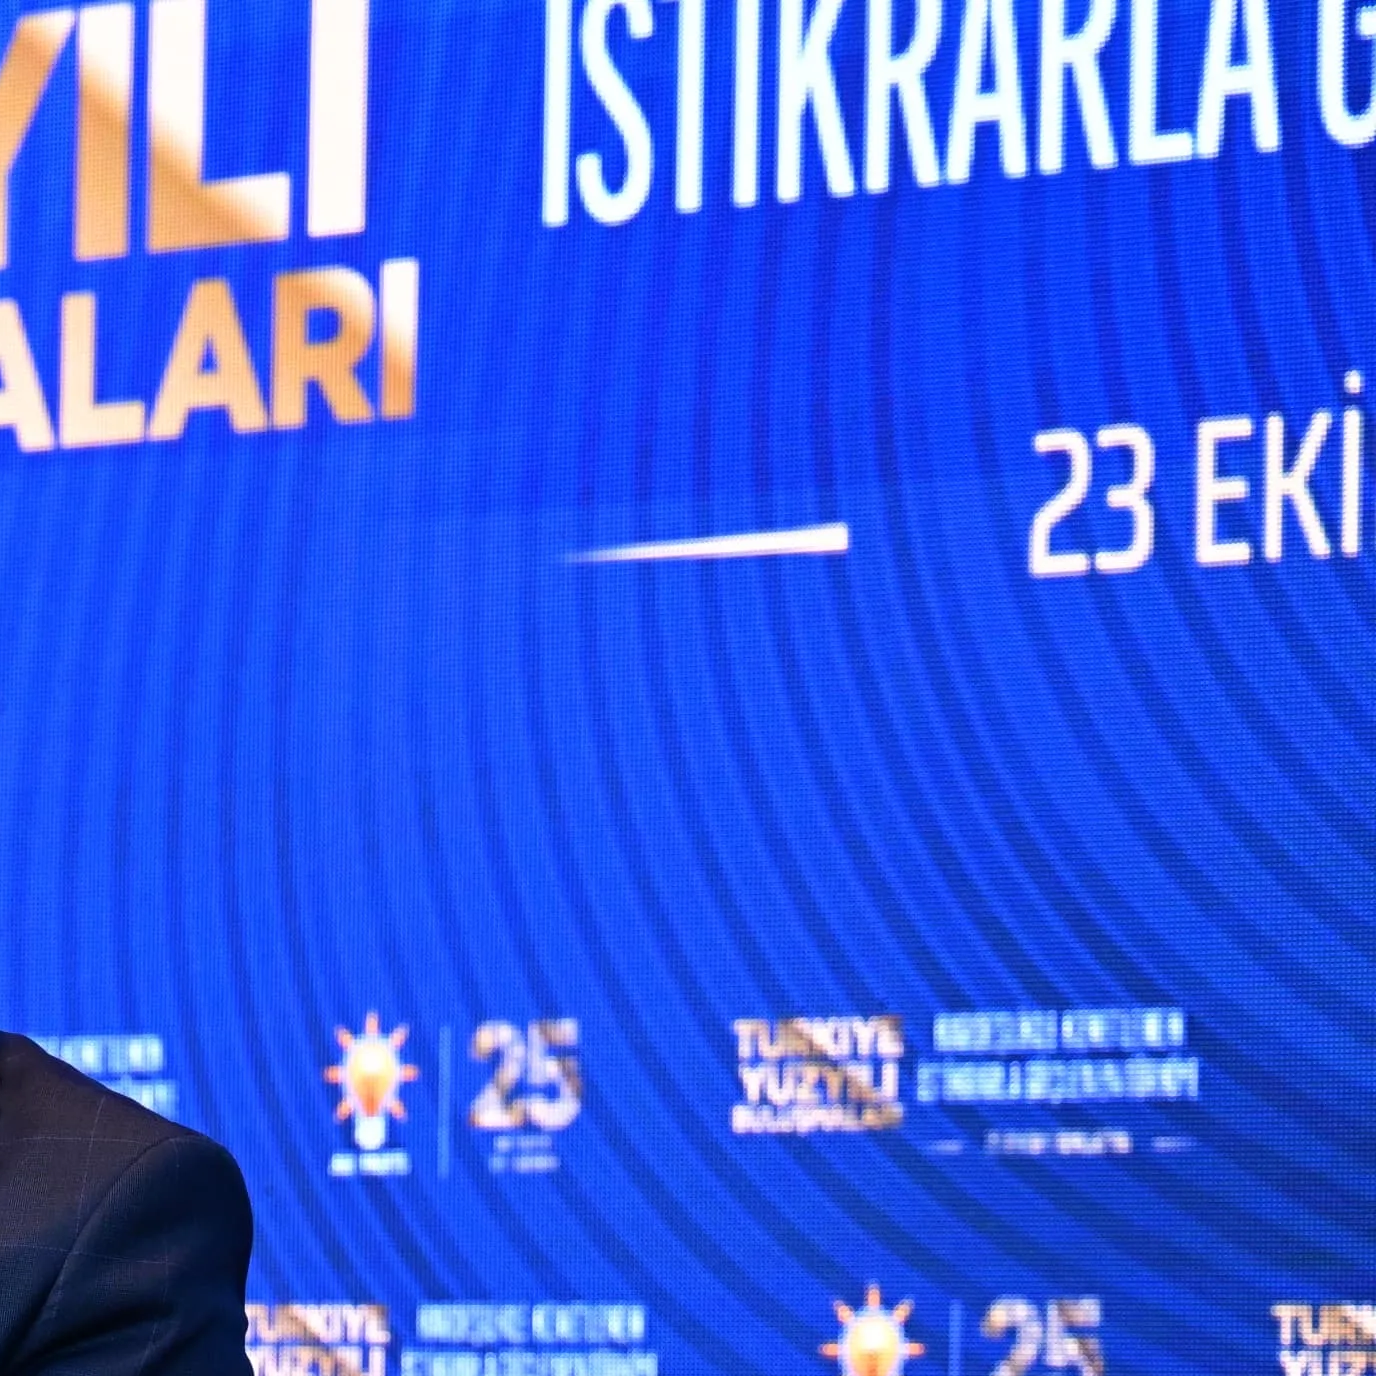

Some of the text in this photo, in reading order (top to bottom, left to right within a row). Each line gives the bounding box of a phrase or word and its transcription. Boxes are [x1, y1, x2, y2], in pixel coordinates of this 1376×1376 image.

[1028, 369, 1363, 579] 23 EKİ
[469, 1016, 582, 1130] 25
